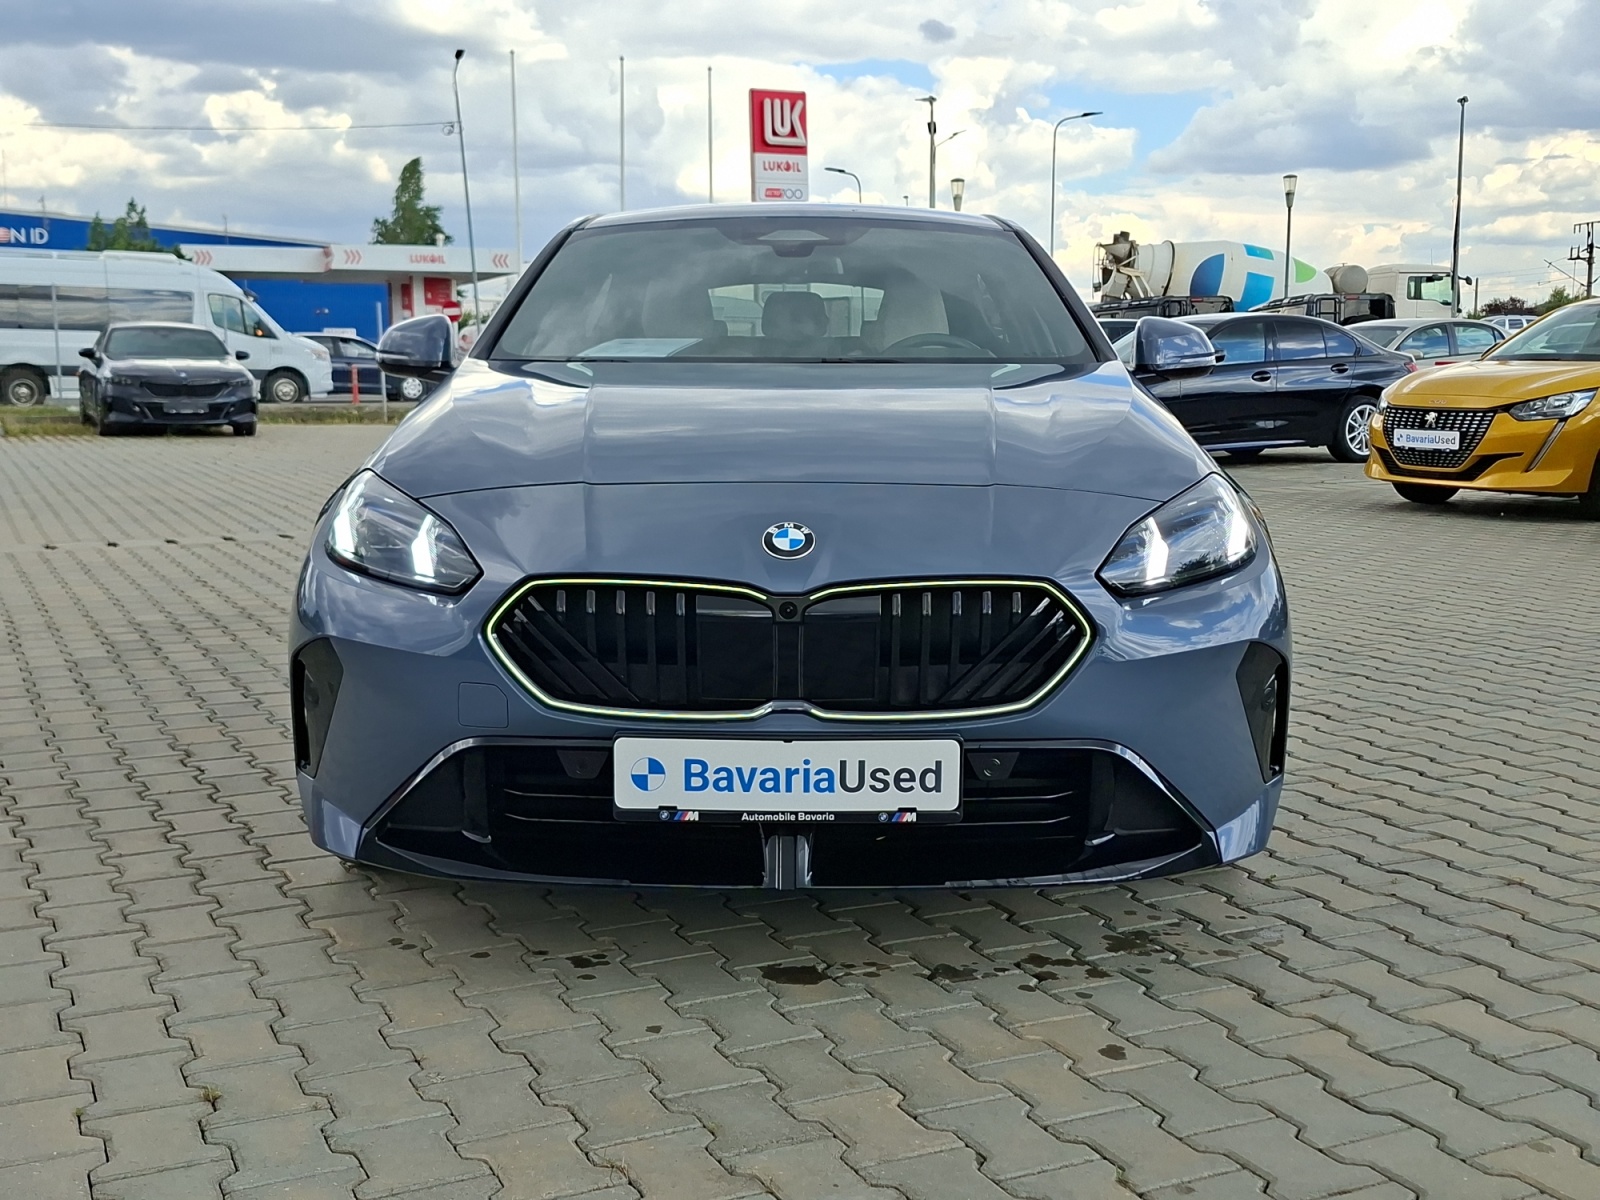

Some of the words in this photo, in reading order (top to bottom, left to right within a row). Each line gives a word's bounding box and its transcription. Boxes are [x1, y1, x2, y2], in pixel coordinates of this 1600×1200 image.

[763, 160, 802, 173] LUKOIL
[30, 227, 49, 245] ID
[410, 253, 446, 265] LUKOIL
[1405, 433, 1456, 445] BavariaUsed
[683, 757, 943, 794] BavariaUsed
[741, 812, 796, 822] Automobile
[798, 812, 835, 821] Bavaria
